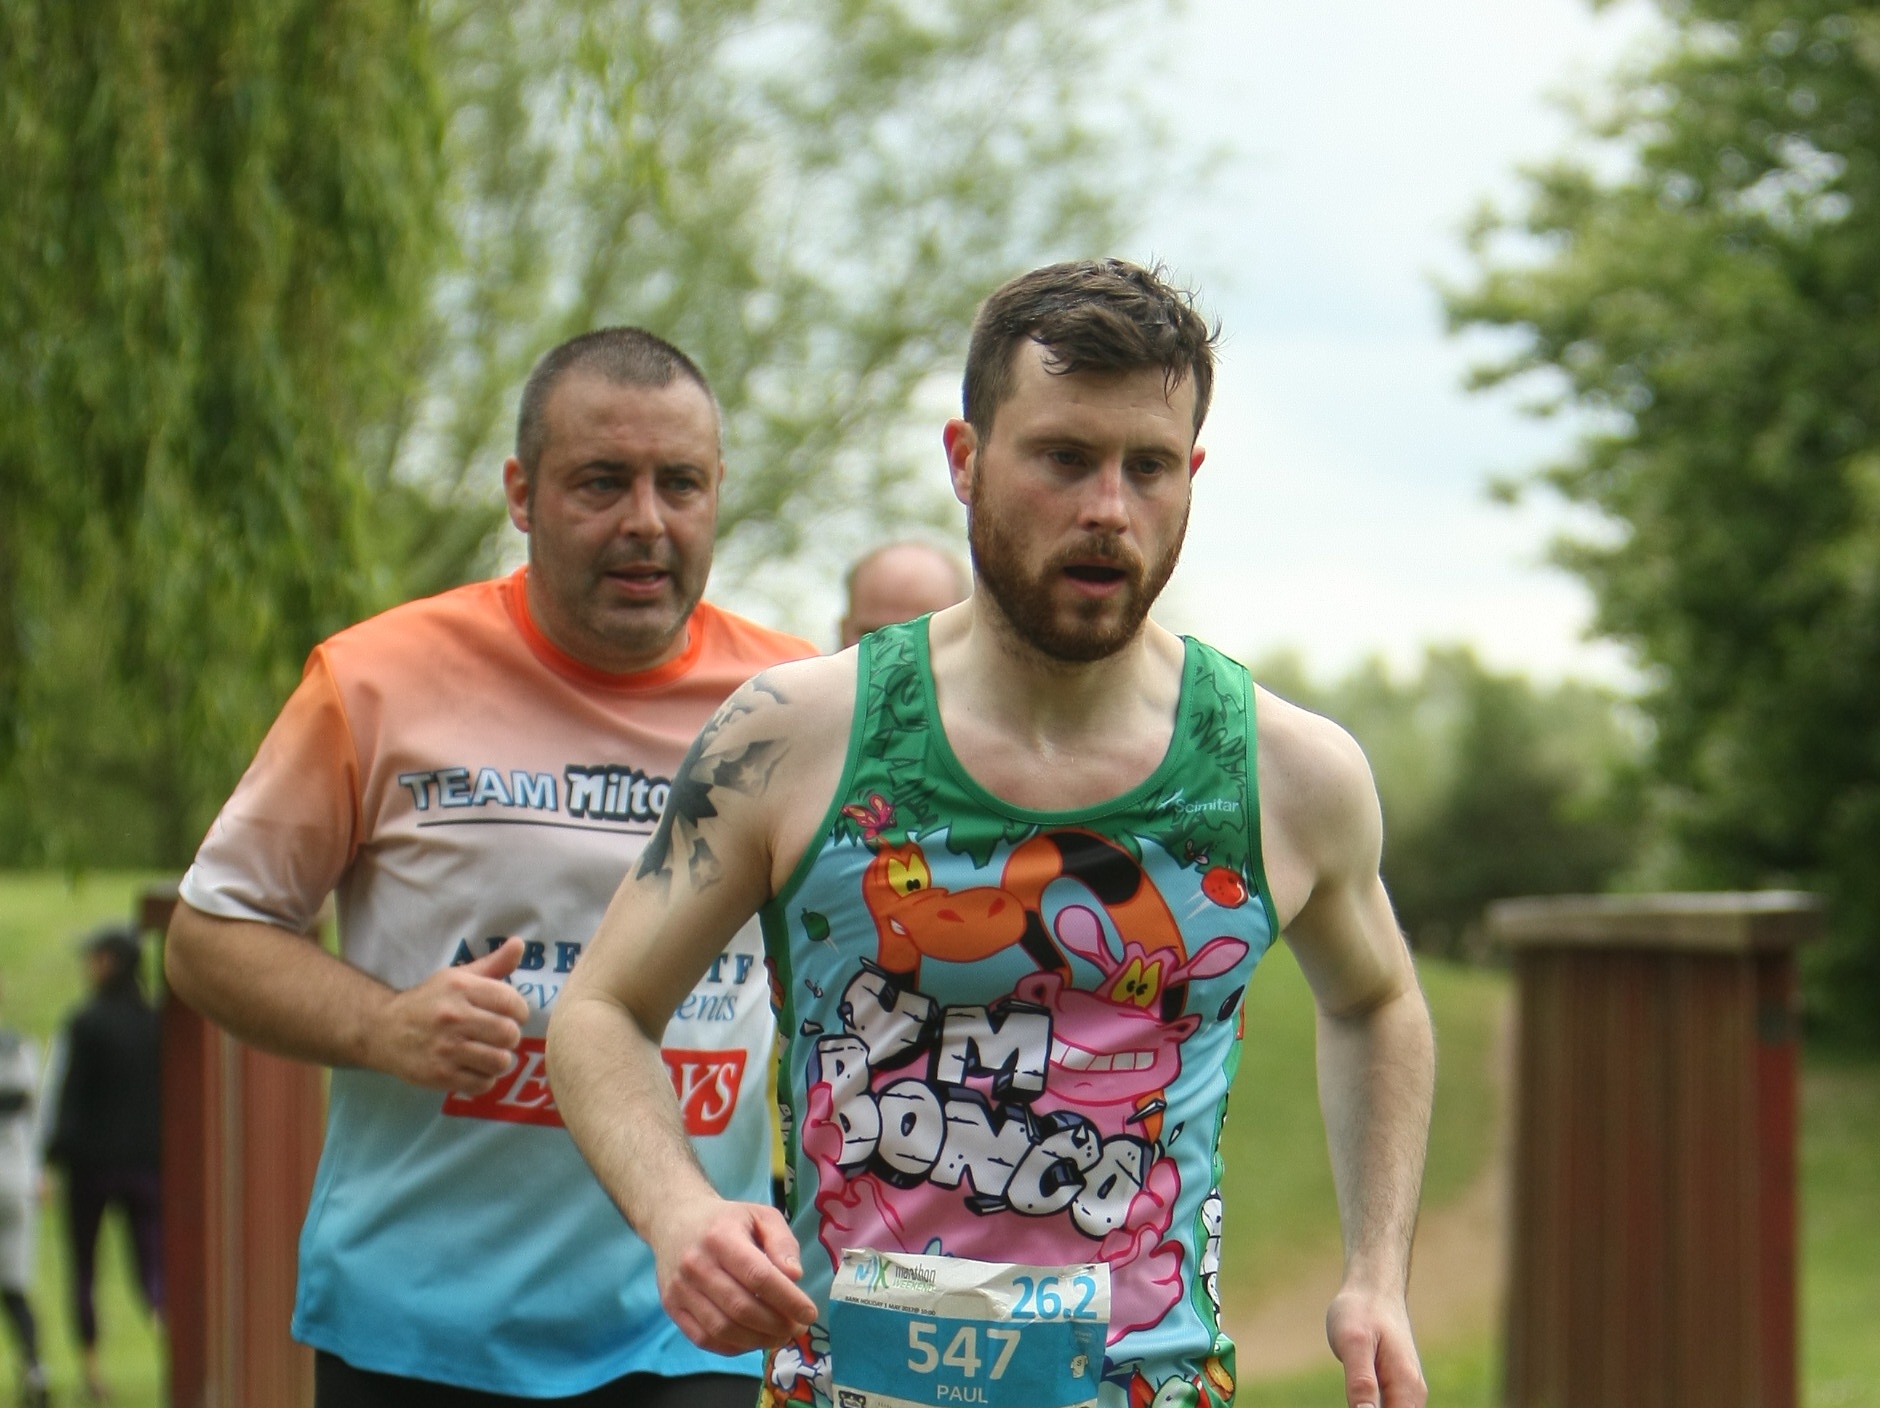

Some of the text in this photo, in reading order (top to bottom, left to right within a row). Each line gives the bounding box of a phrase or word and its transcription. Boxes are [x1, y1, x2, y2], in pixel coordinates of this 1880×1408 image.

[398, 764, 671, 823] TEAM Milto
[1175, 798, 1239, 814] Scimitar
[894, 1263, 937, 1283] marathon
[845, 1296, 860, 1304] BANK
[861, 1298, 884, 1307] HOLIDAY
[1011, 1275, 1097, 1320] 26.2
[908, 1321, 1021, 1380] 547
[937, 1385, 988, 1404] PAUL
